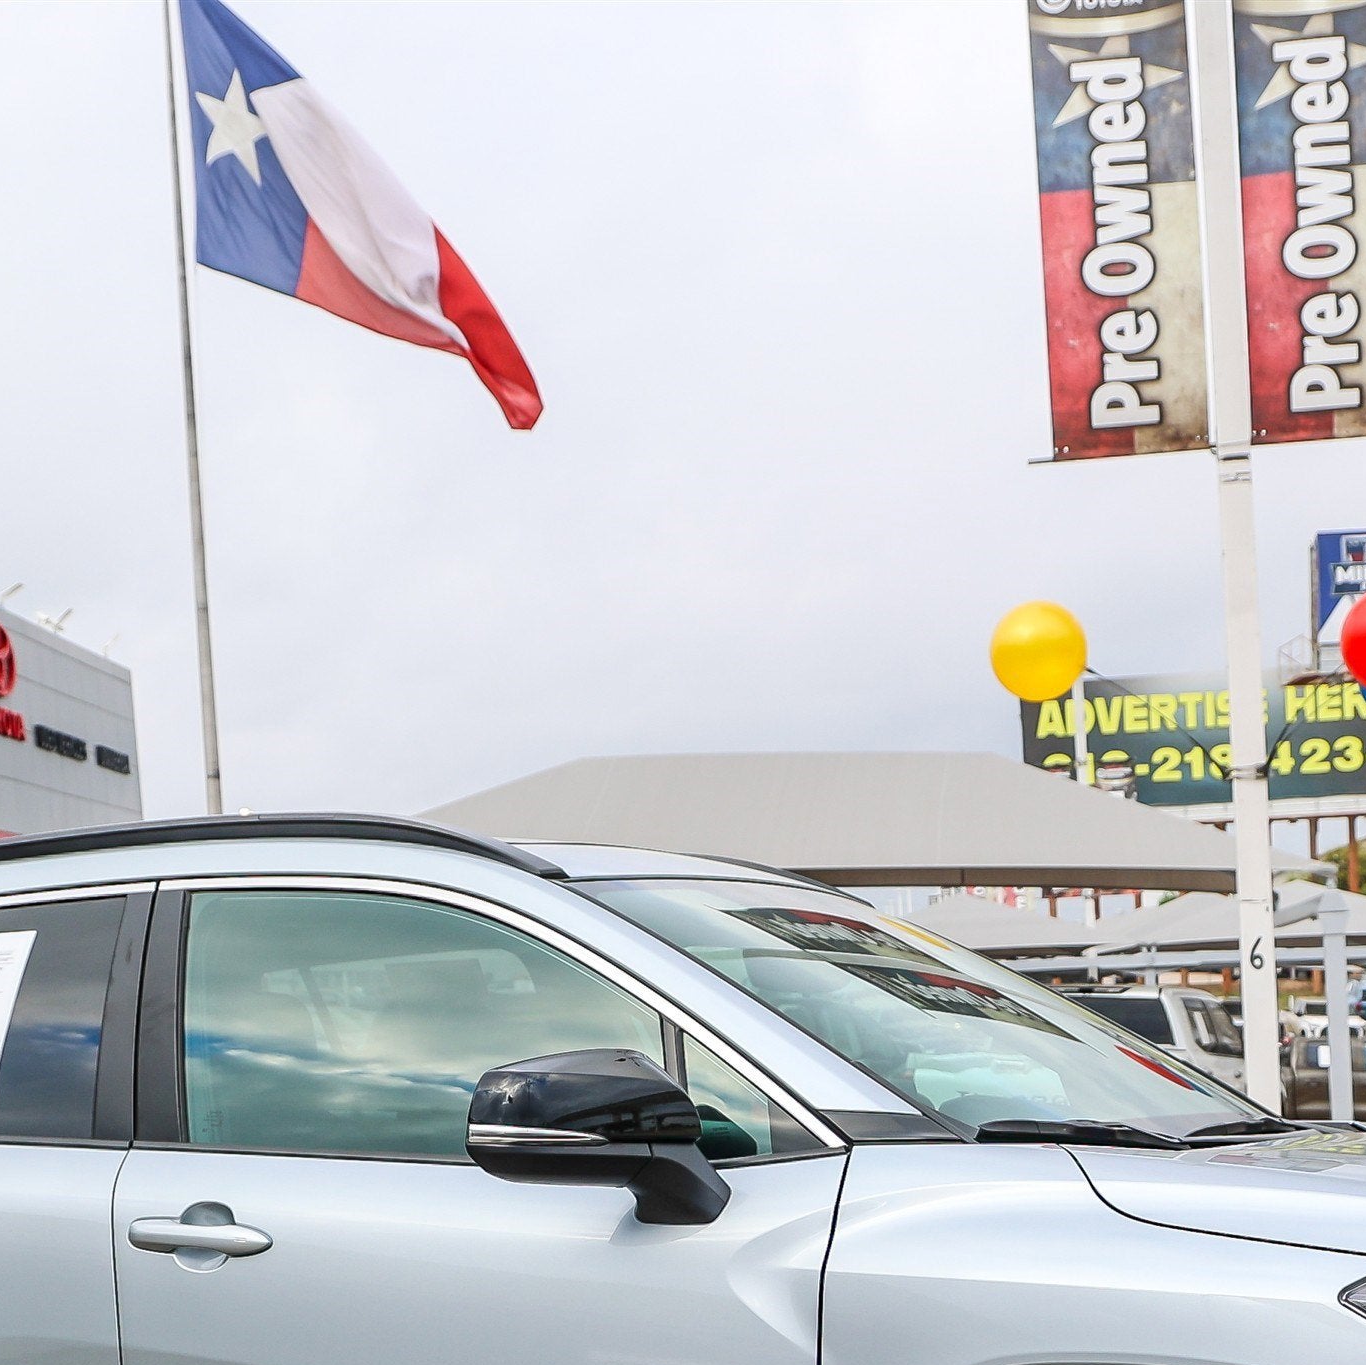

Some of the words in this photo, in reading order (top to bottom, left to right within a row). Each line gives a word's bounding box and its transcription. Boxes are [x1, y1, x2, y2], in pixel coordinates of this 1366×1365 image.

[1069, 56, 1155, 297] Owned
[1274, 34, 1357, 280] Owned
[1090, 308, 1162, 430] Pre
[1289, 292, 1361, 414] Pre
[1250, 936, 1264, 970] 6
